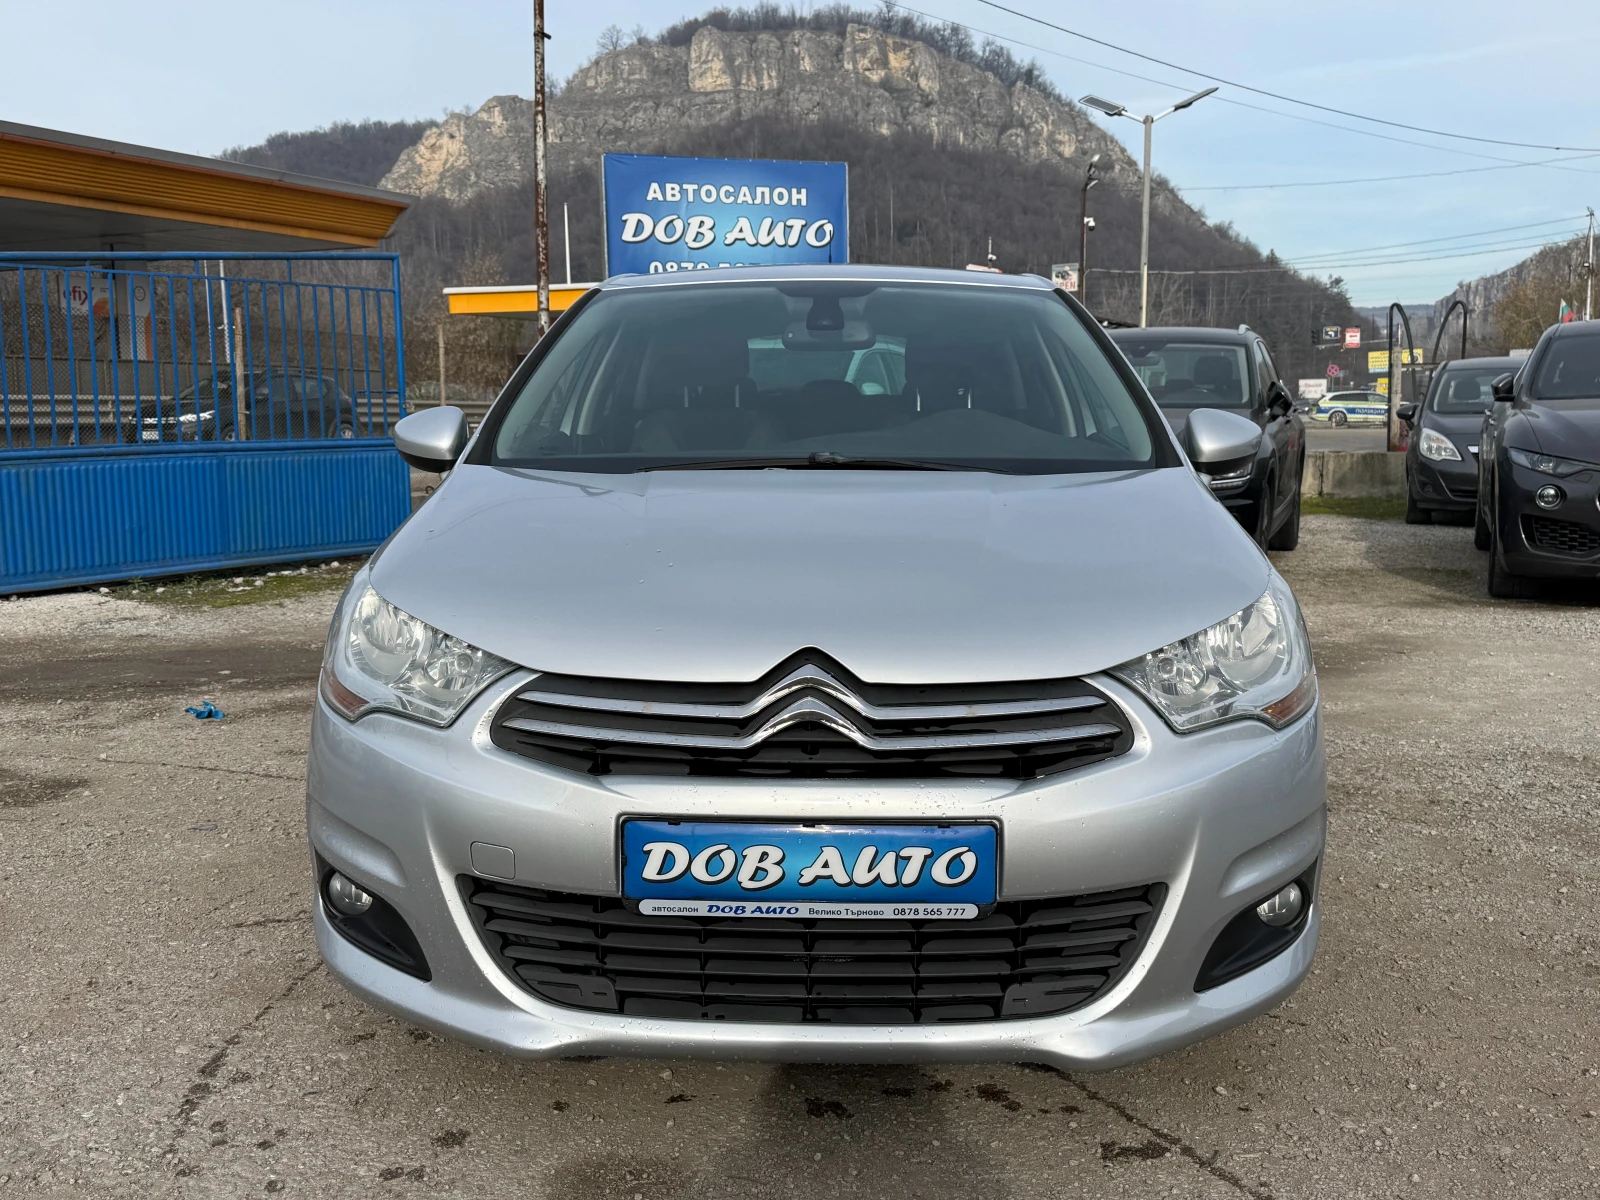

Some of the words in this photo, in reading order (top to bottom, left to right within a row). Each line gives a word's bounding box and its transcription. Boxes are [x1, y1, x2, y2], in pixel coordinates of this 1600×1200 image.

[646, 182, 808, 206] АВТОСАЛОН
[621, 212, 715, 250] DOB
[724, 216, 835, 248] AUTO
[1055, 281, 1076, 290] PEN
[641, 841, 785, 891] DOB
[798, 845, 978, 888] AUTO
[651, 905, 699, 914] автосалон
[707, 904, 747, 915] DOB
[750, 905, 799, 915] AUTO
[808, 908, 842, 916] Велико
[843, 908, 885, 917] Търново
[893, 908, 920, 917] 0878
[923, 908, 943, 917] 565
[946, 908, 966, 917] 777
